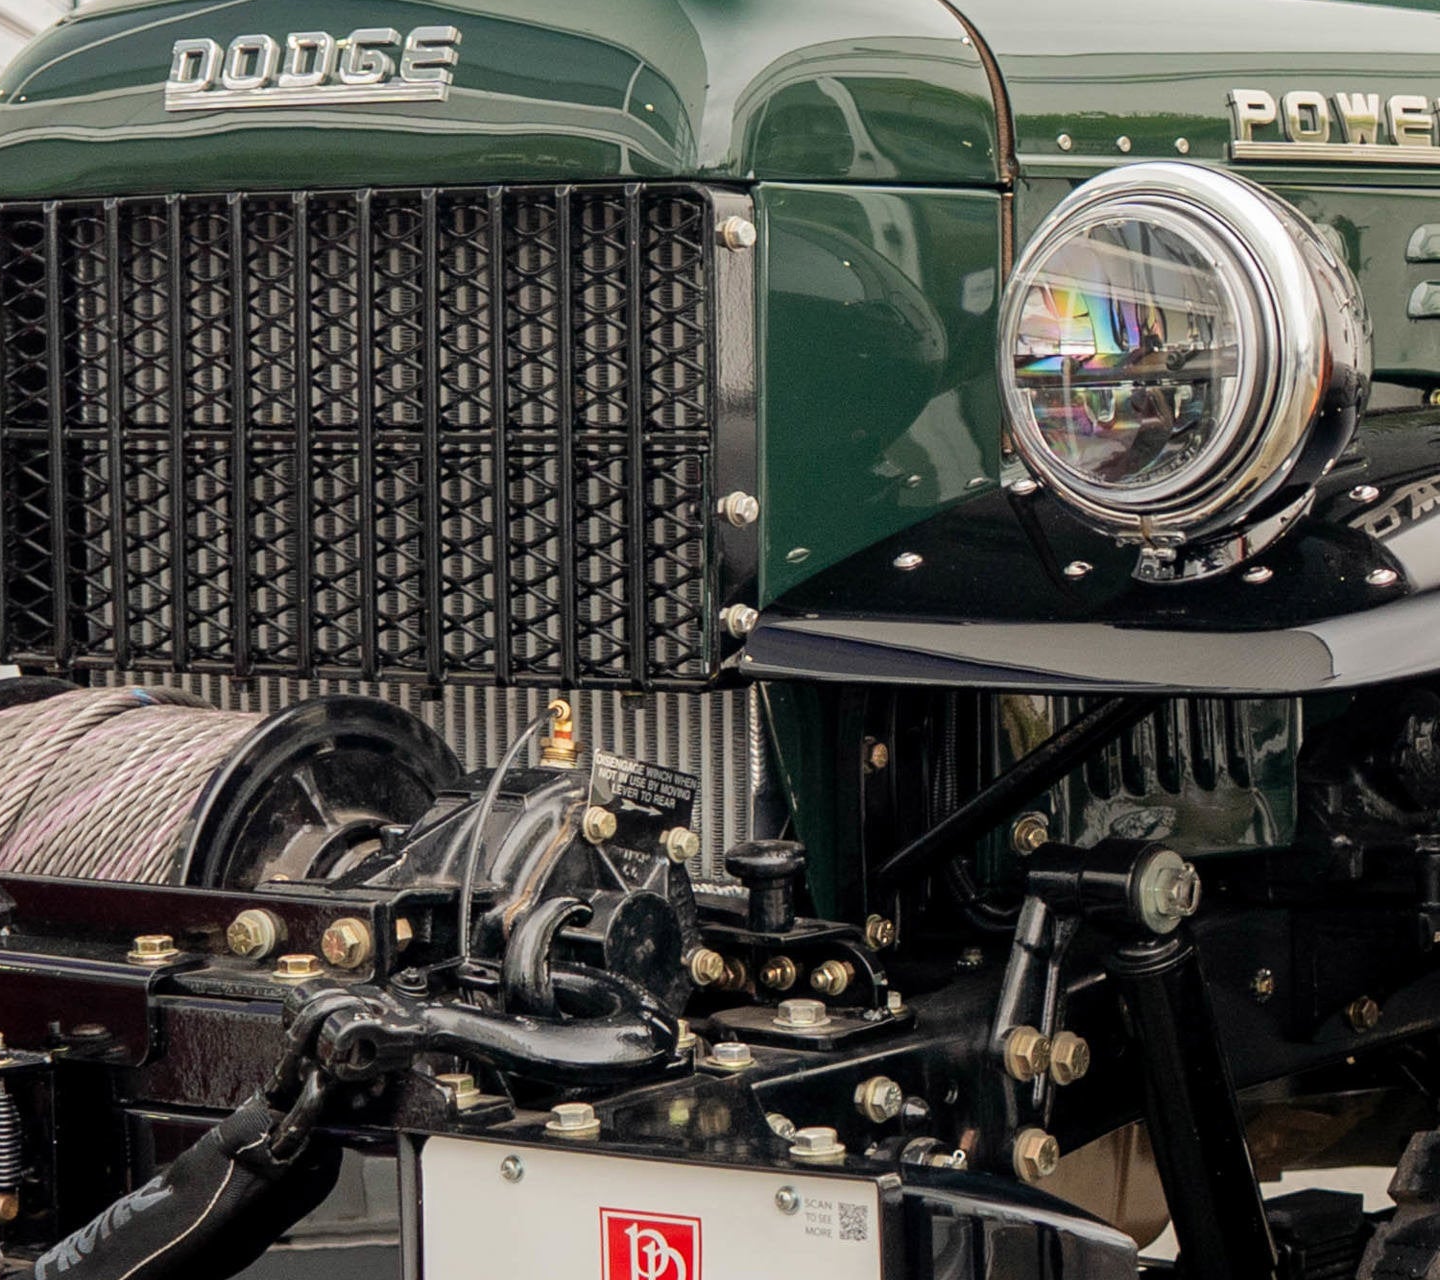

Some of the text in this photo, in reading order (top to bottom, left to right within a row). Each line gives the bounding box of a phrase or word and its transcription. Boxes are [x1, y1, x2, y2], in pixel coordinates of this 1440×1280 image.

[167, 25, 462, 92] DODGE
[596, 753, 698, 788] DISENGAGE WINCH WHEN
[598, 767, 691, 800] NOT IN USE BY MOVING
[612, 783, 676, 809] LEVER TO REAR
[804, 1198, 832, 1210] SCAN
[805, 1211, 817, 1222] TO
[805, 1226, 832, 1238] MORE
